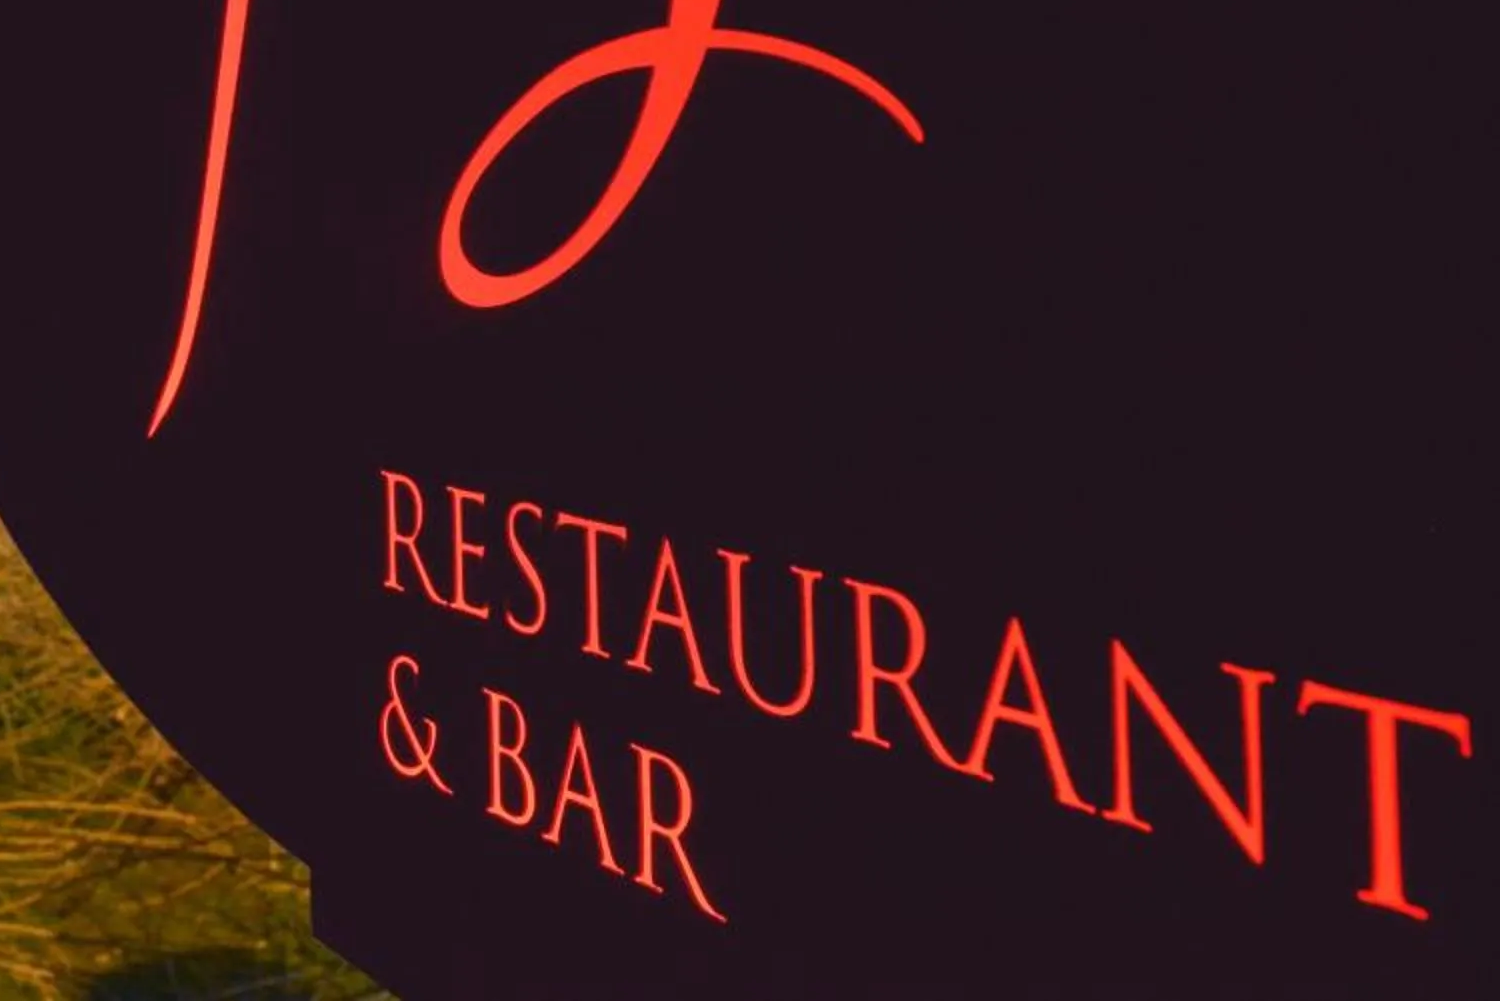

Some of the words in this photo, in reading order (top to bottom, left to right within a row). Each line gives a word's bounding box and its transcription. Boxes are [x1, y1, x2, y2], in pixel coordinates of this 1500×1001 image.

[379, 654, 453, 795] &
[484, 688, 727, 922] BAR
[381, 470, 1473, 920] RESTAURANT
